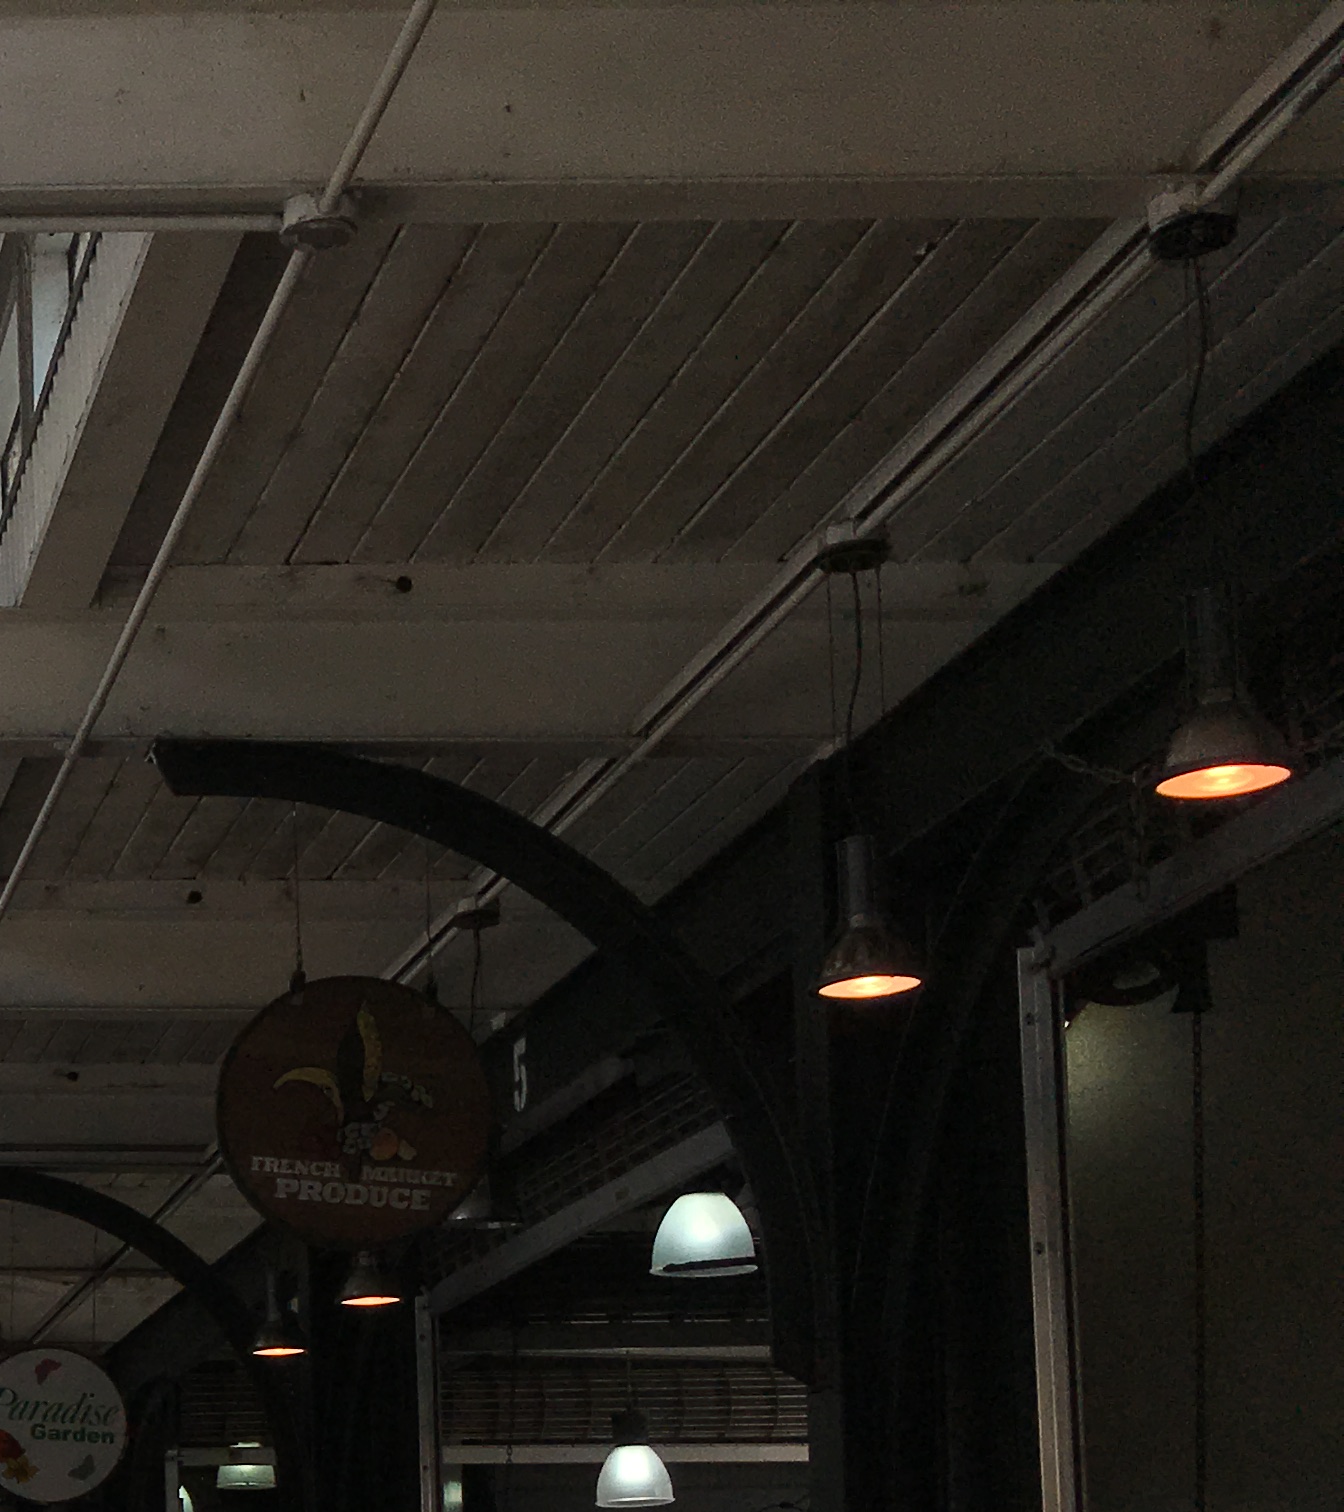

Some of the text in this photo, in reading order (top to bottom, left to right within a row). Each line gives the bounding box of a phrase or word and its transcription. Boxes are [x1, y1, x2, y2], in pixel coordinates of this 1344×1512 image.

[250, 1156, 458, 1187] FRENCH MARKET
[274, 1178, 431, 1211] PRODUCE
[30, 1423, 115, 1444] Garden
